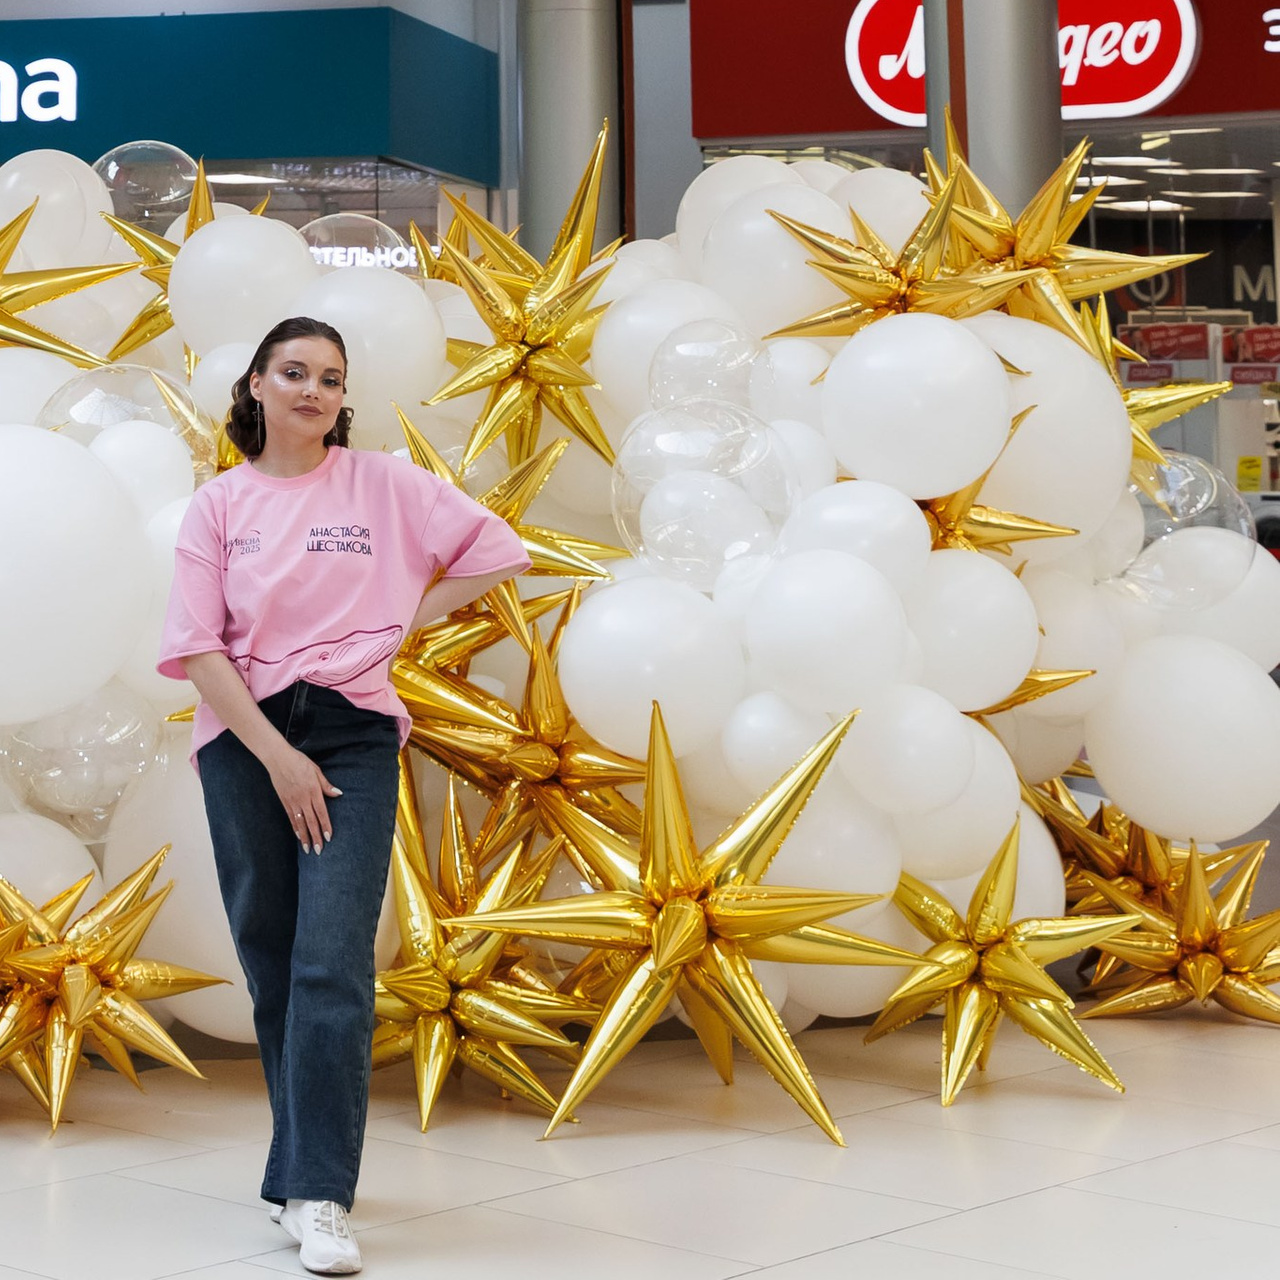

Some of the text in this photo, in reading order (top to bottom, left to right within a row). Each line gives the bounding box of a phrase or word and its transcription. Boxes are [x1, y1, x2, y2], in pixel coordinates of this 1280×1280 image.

[309, 525, 370, 540] АНАСТАСИЯ
[235, 537, 260, 546] ВЕСНА
[307, 540, 373, 556] ШЕСТАКОВА
[240, 544, 261, 555] 2025
